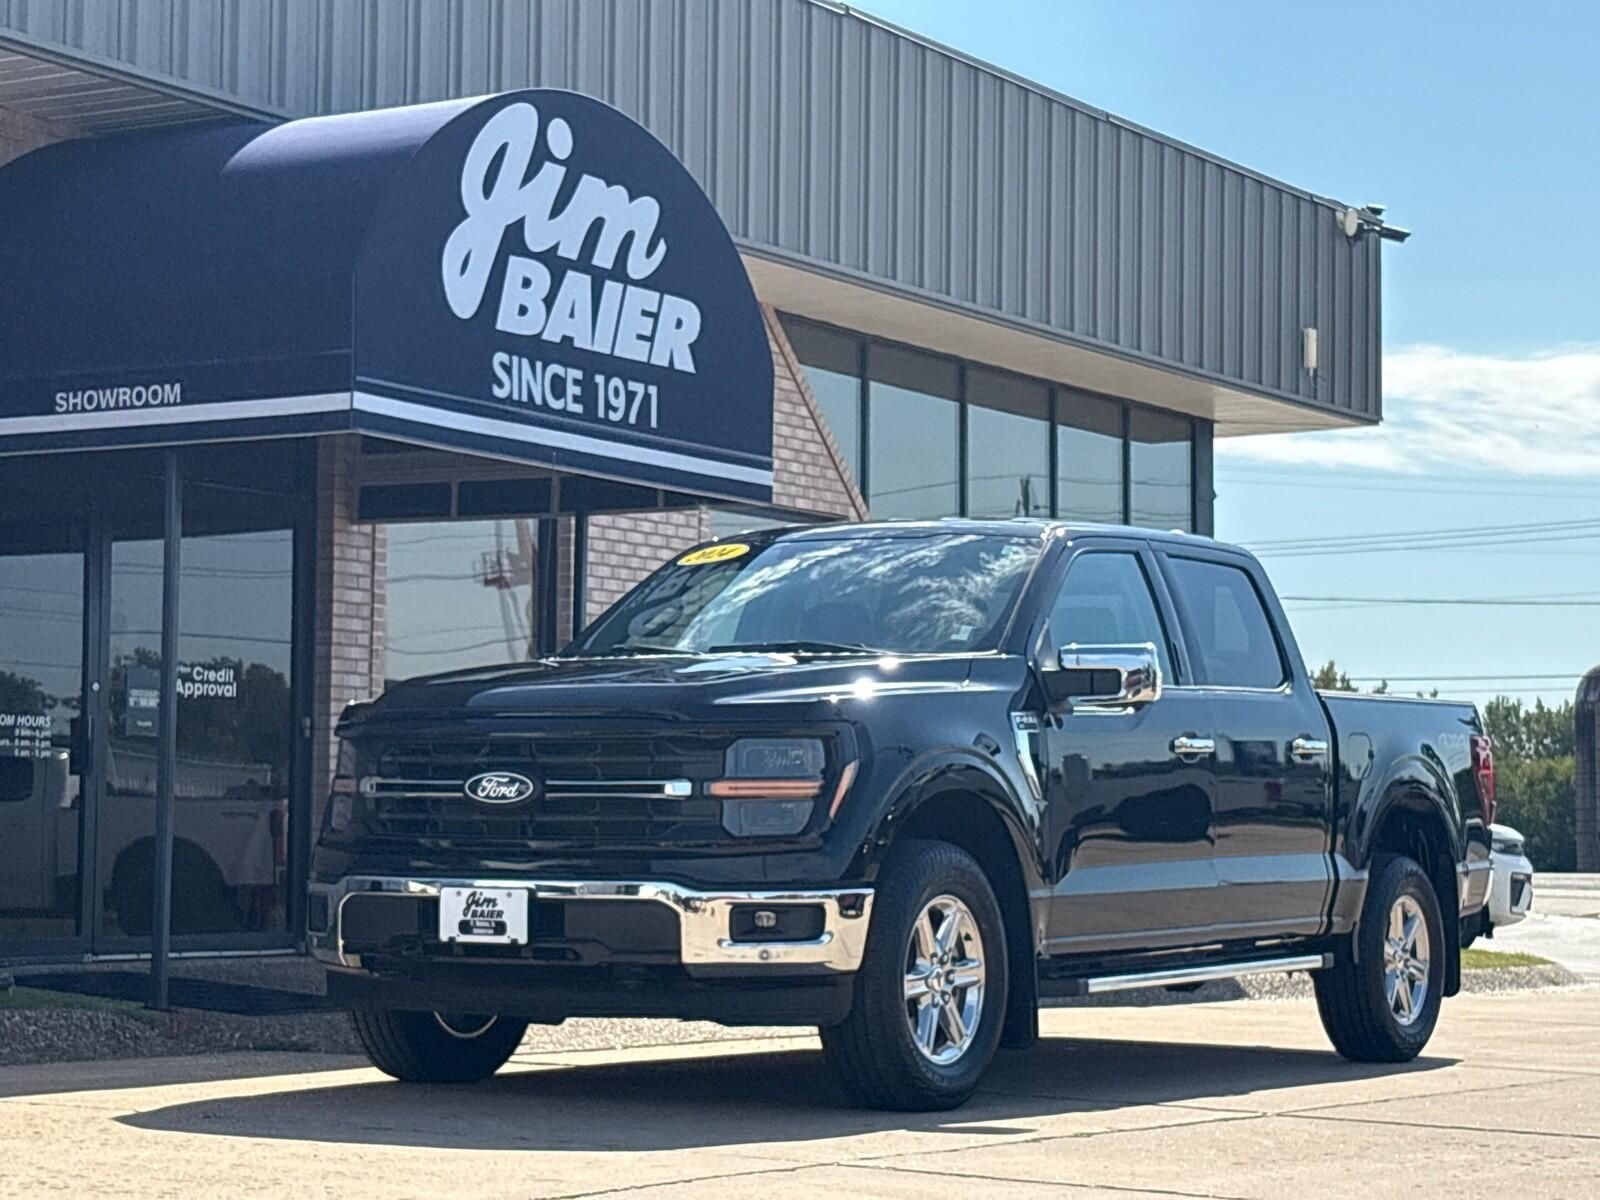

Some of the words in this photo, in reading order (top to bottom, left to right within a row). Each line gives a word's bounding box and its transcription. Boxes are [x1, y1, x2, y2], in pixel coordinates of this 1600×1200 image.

[442, 102, 667, 320] Jim
[495, 255, 701, 374] BAIER
[55, 382, 181, 412] SHOWROOM
[492, 351, 583, 414] SINCE
[594, 374, 658, 428] 1971
[193, 666, 234, 682] Credit
[176, 678, 237, 699] Approval
[17, 714, 52, 729] HOURS
[477, 776, 520, 798] Ford
[463, 890, 499, 918] Jim
[470, 909, 505, 919] BAIER
